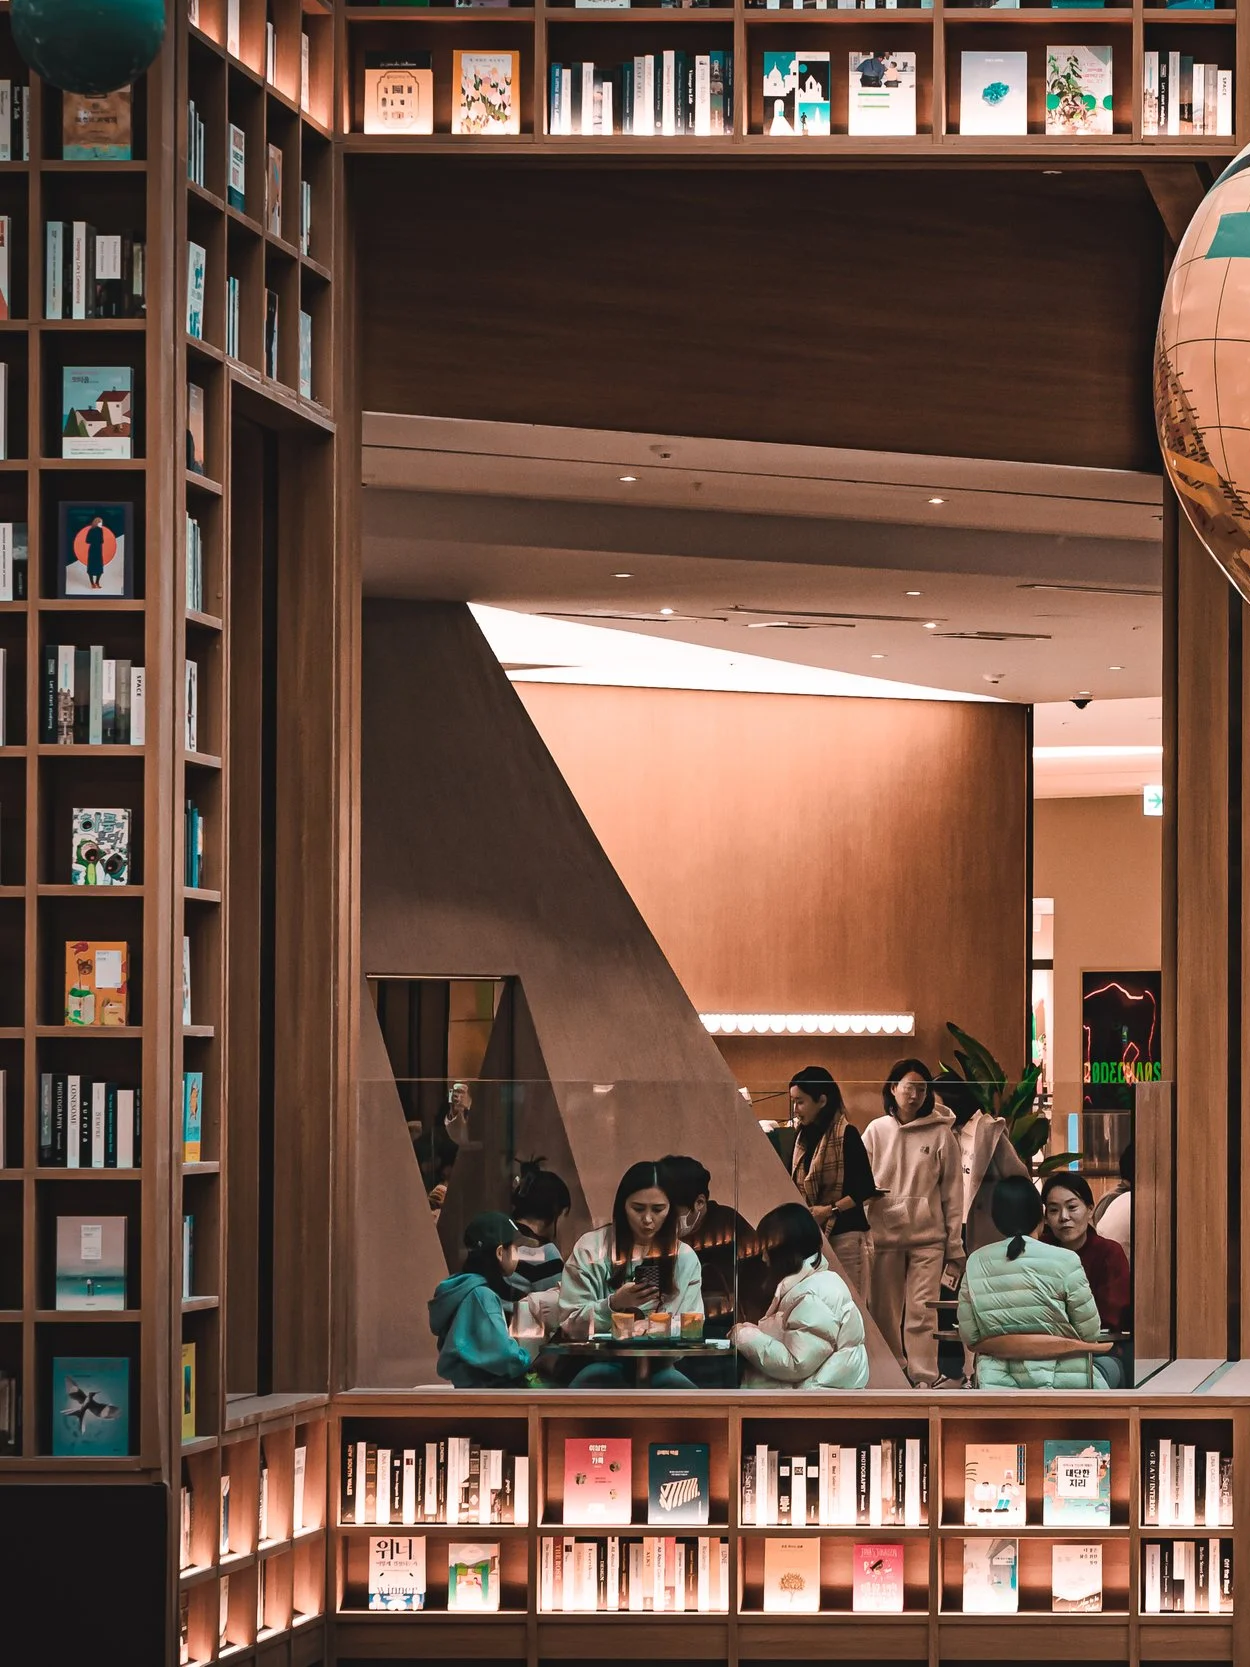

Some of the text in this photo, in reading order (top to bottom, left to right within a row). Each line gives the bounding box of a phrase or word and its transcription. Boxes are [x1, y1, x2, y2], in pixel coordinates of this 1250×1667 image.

[56, 1081, 64, 1130] PHOTOGRAPHY
[70, 1083, 78, 1126] LONESOME
[94, 1112, 102, 1139] SEMPRE
[1065, 1469, 1090, 1479] 대단한
[1068, 1479, 1086, 1488] 지리
[1222, 1477, 1230, 1491] San
[376, 1539, 413, 1560] 위너
[376, 1584, 418, 1595] winner
